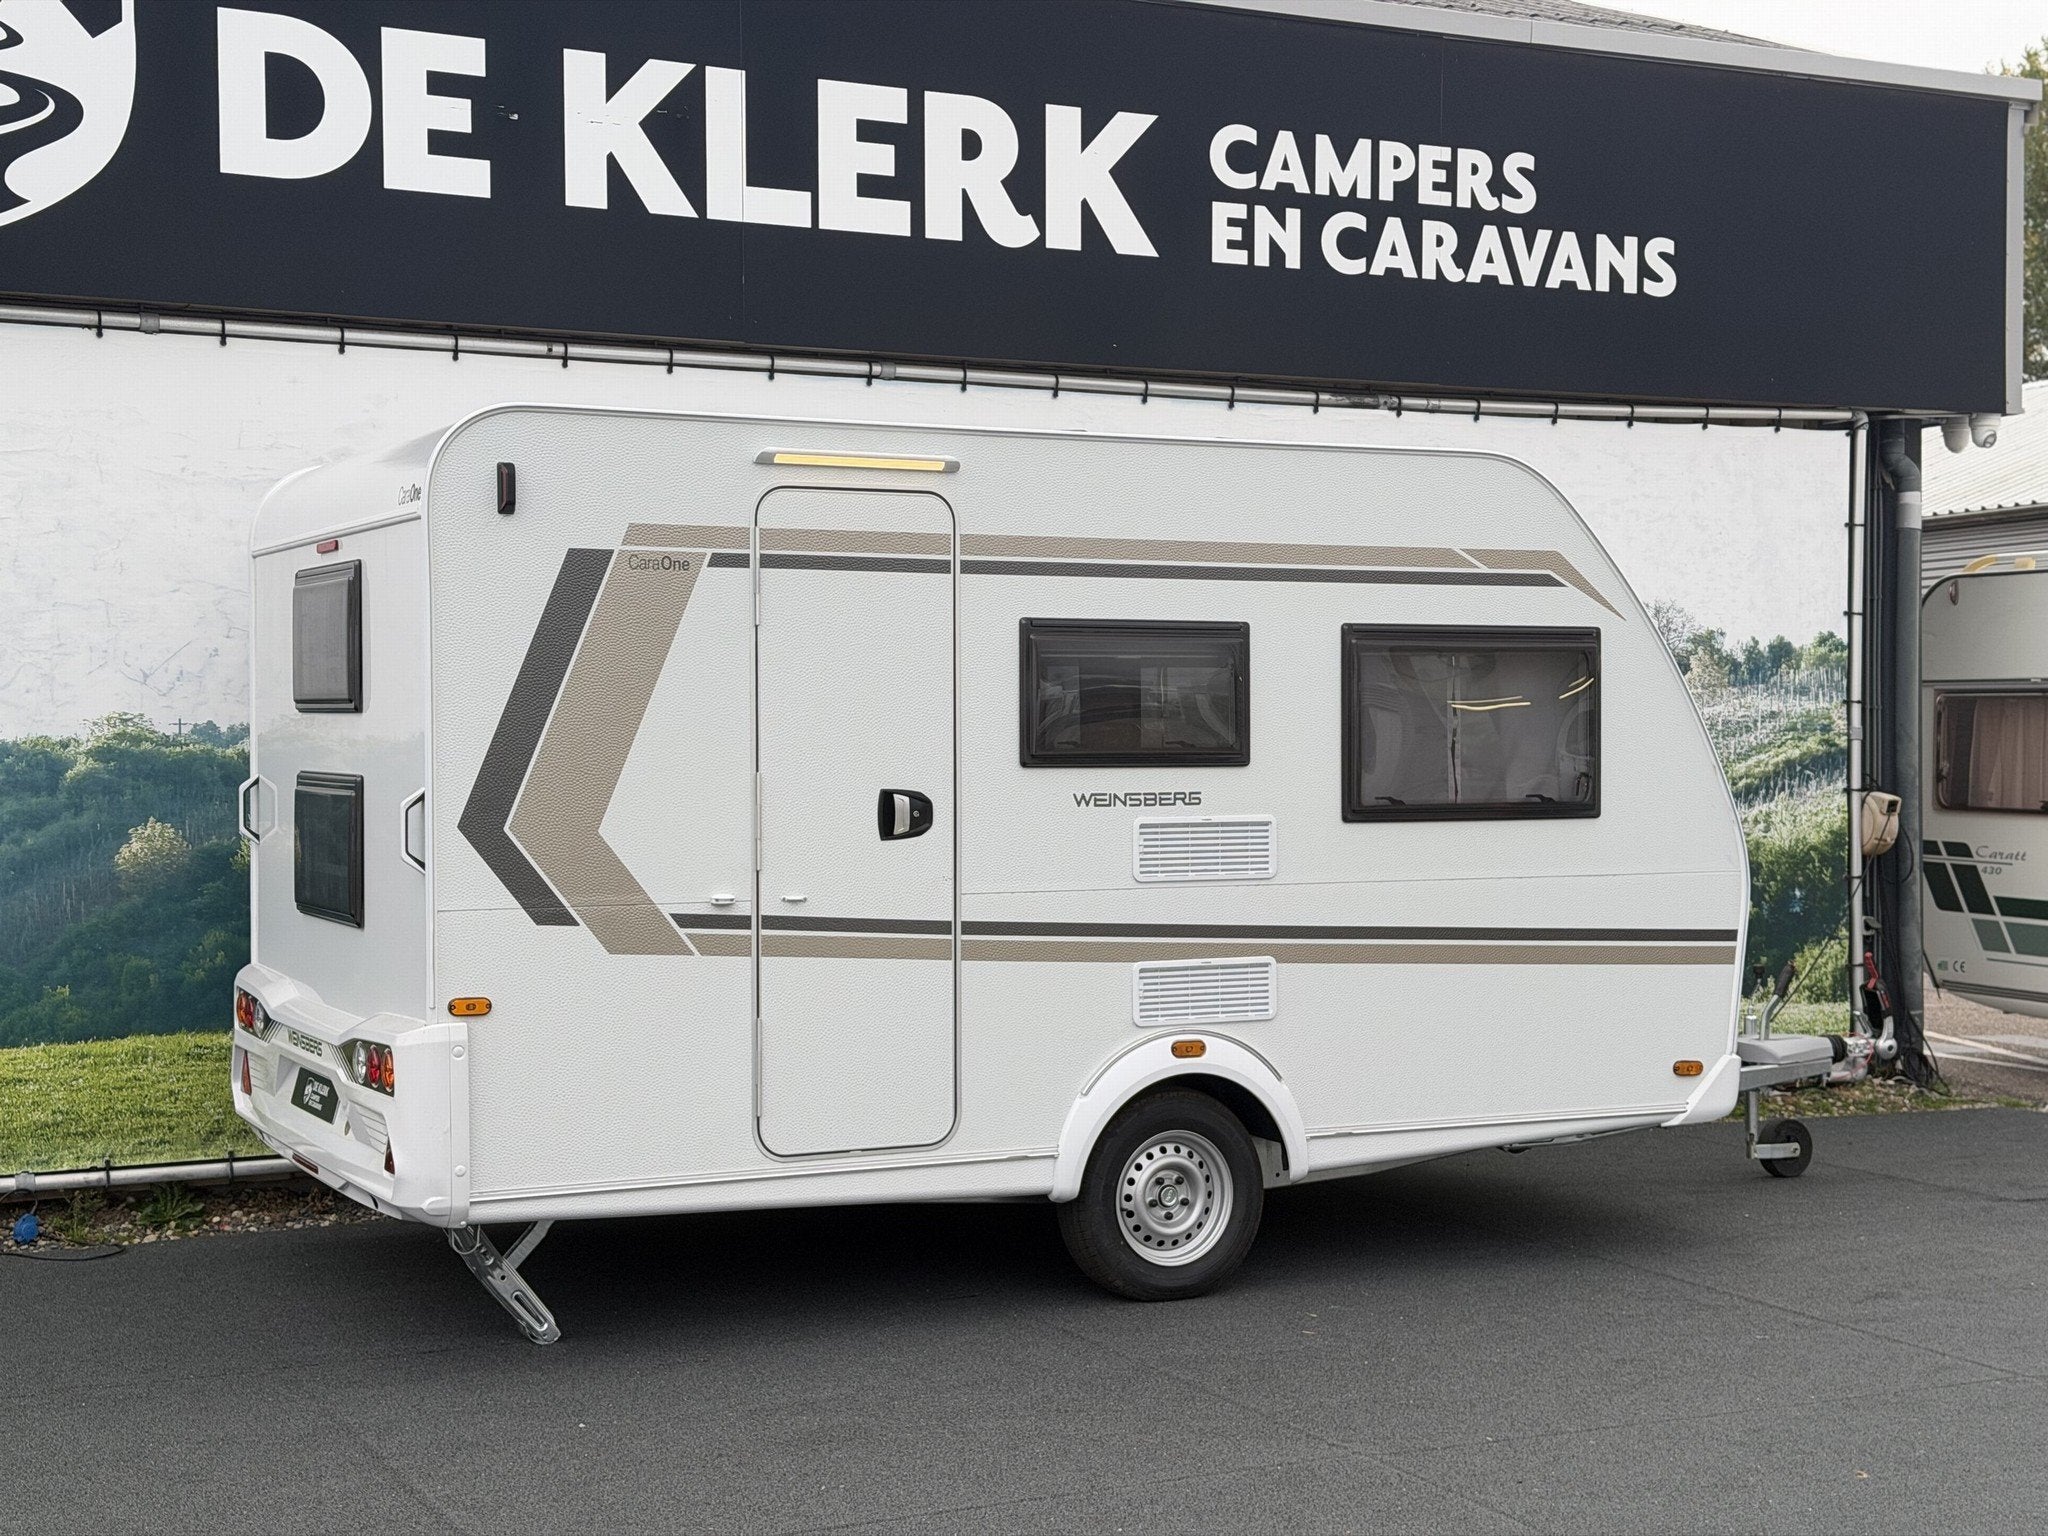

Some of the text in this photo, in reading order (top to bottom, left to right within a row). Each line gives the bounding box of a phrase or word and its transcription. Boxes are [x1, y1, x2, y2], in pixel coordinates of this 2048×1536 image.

[216, 6, 1160, 258] DE KLERK
[1209, 123, 1537, 215] CAMPERS
[1211, 200, 1678, 298] EN CARAVANS
[628, 554, 690, 571] CaraOne
[1072, 791, 1202, 808] WEINSBERG
[1981, 865, 2002, 876] 430
